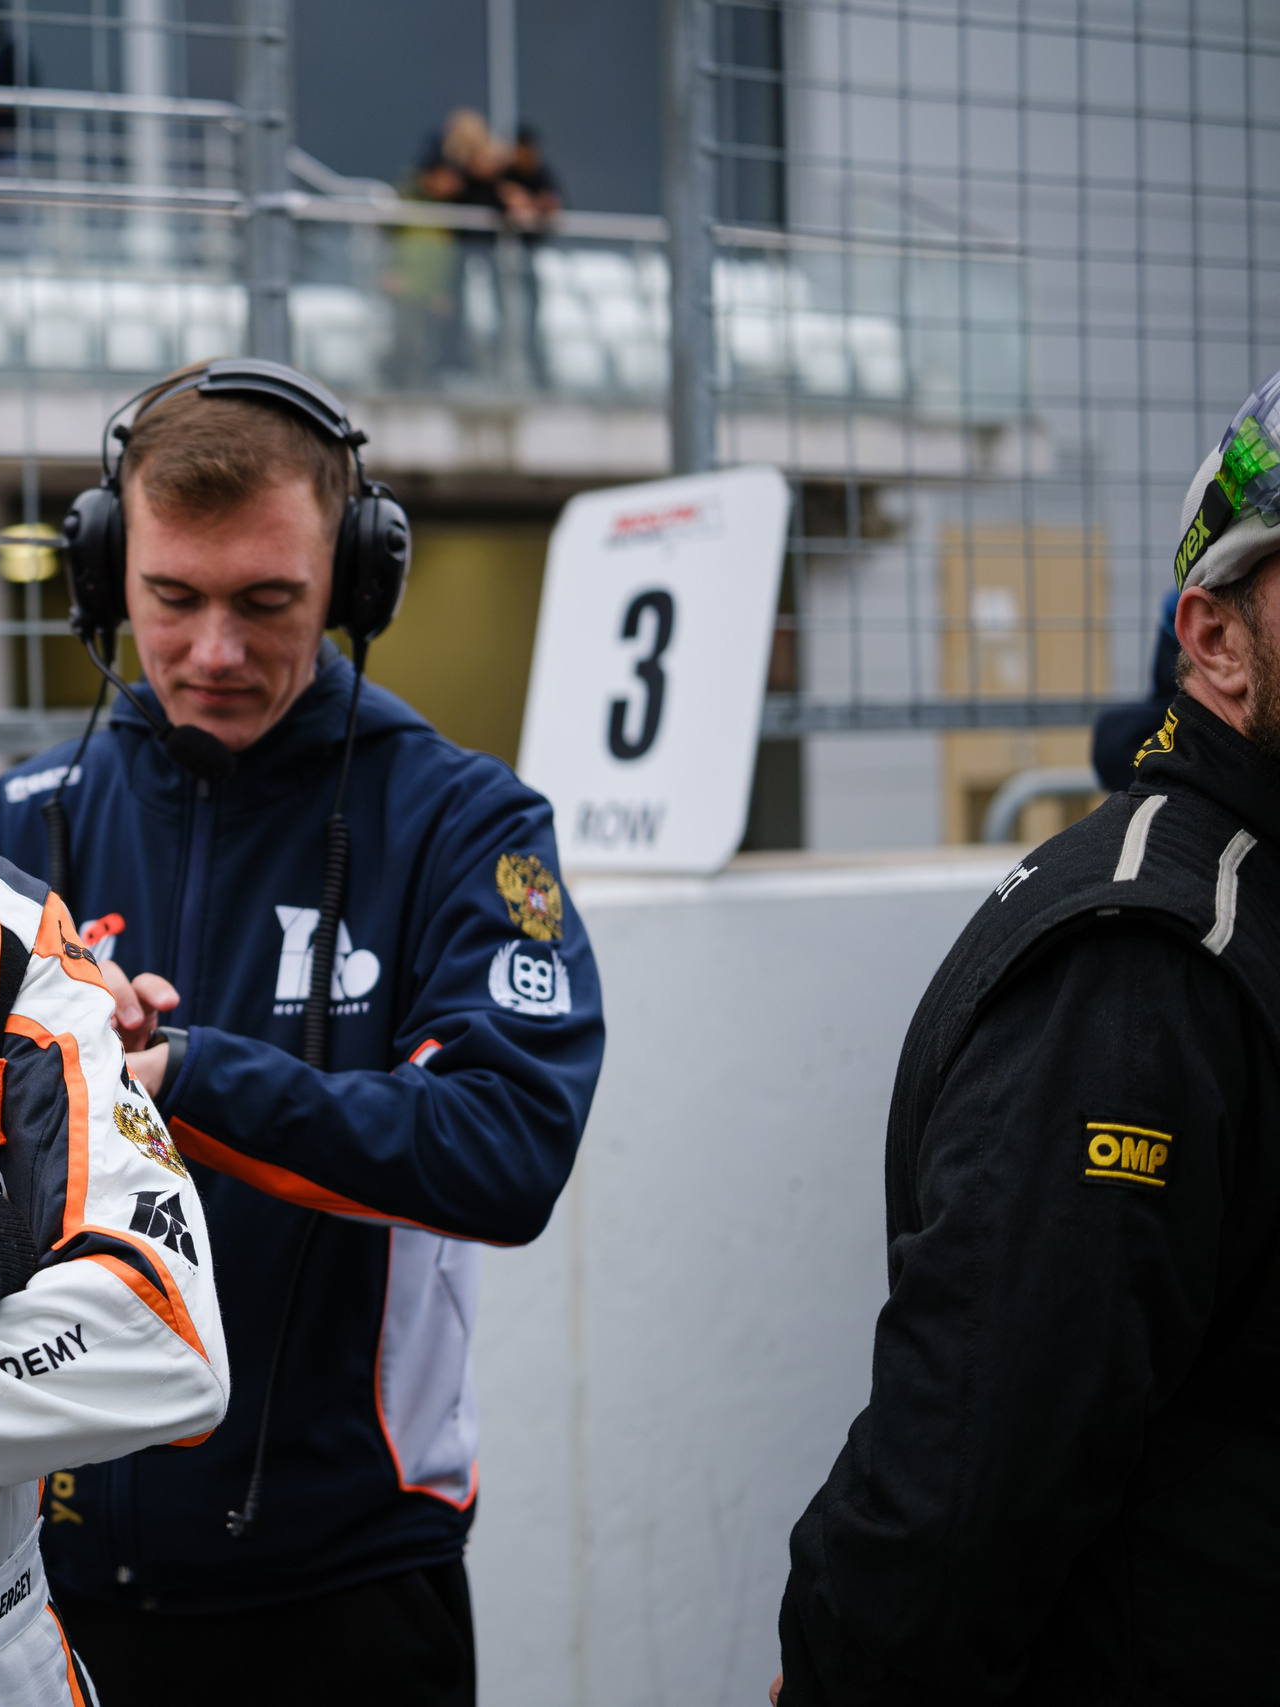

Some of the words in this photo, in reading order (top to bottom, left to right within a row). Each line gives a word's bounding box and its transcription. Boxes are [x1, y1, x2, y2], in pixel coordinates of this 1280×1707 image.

[607, 590, 675, 761] 3
[575, 802, 663, 848] ROW
[1088, 1134, 1168, 1173] OMP
